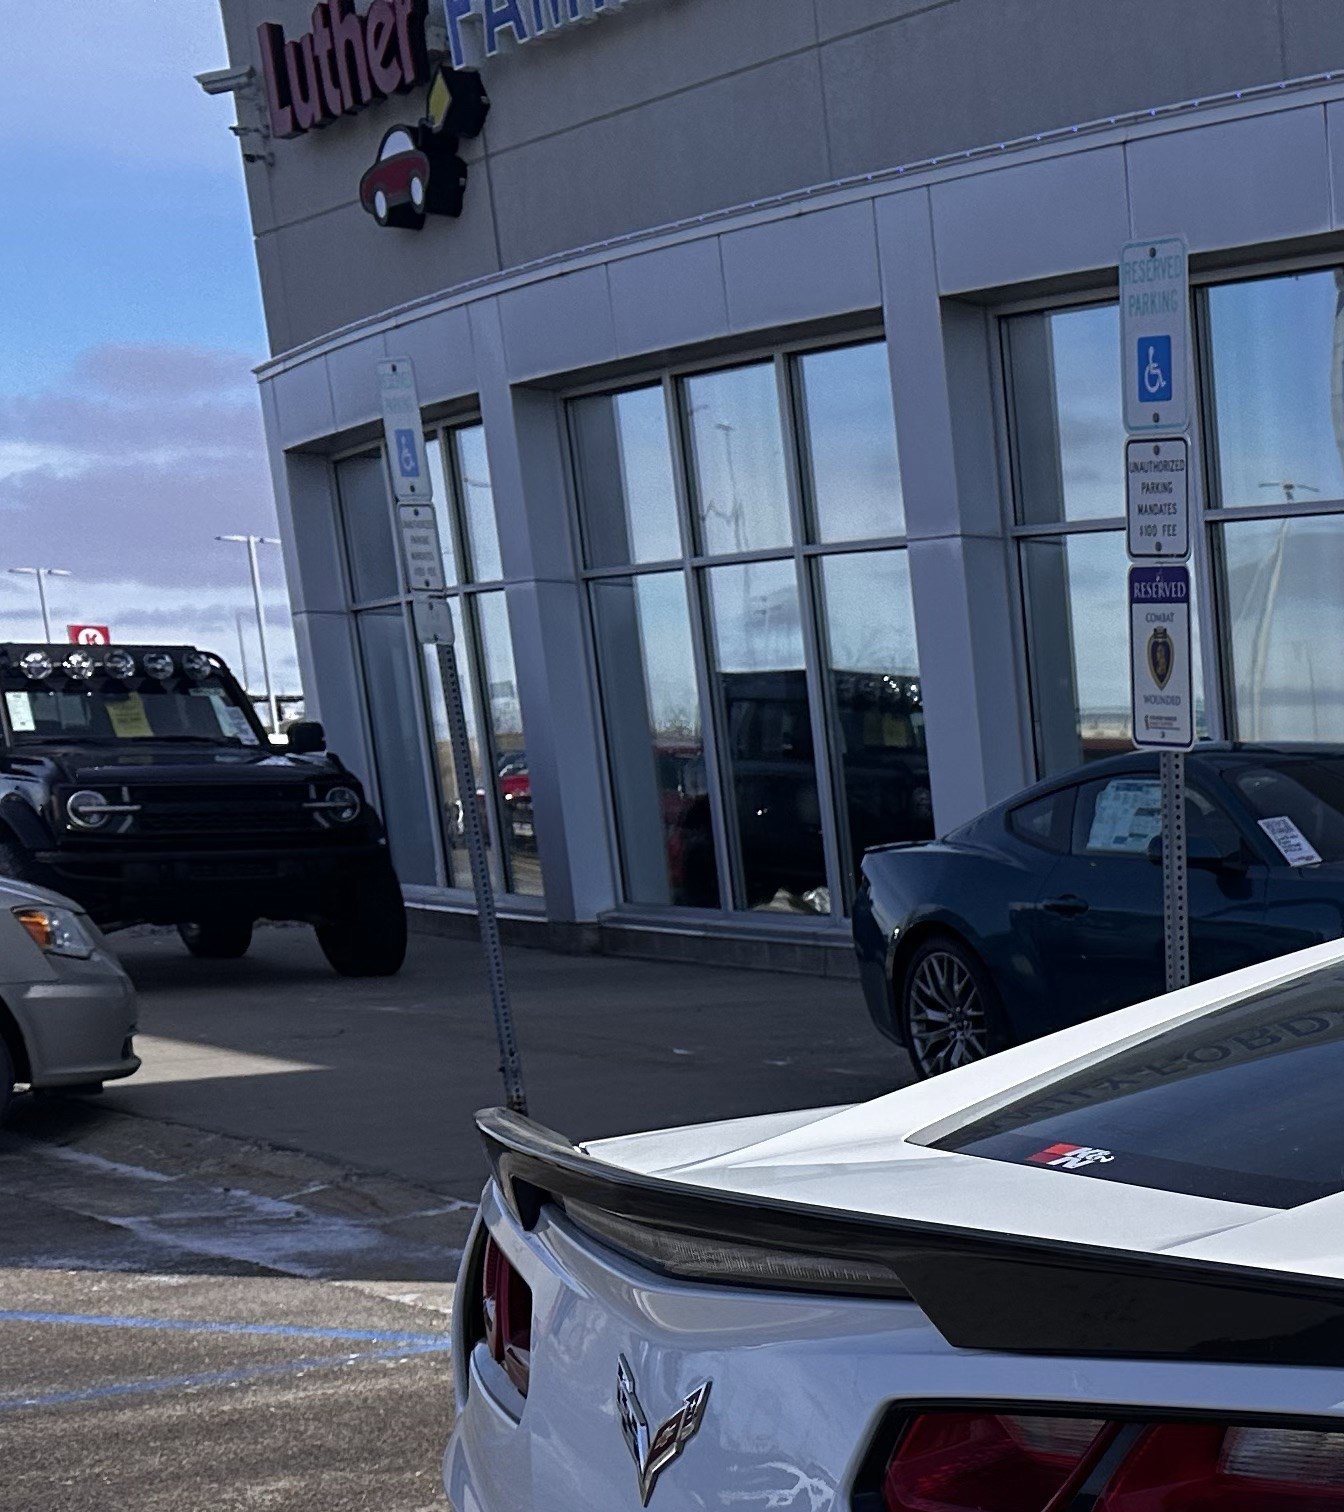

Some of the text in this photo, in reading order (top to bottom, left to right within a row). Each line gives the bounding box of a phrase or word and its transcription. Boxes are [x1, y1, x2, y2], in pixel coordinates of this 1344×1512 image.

[257, 0, 420, 138] Luther
[1123, 255, 1182, 284] RESERVED
[1128, 289, 1179, 316] PARKING
[1129, 459, 1184, 473] UNAUTHORIZED
[1141, 481, 1173, 494] PARKING
[1136, 503, 1177, 515] MANDATES
[1162, 524, 1177, 537] FEE
[1133, 581, 1187, 600] RESERVED
